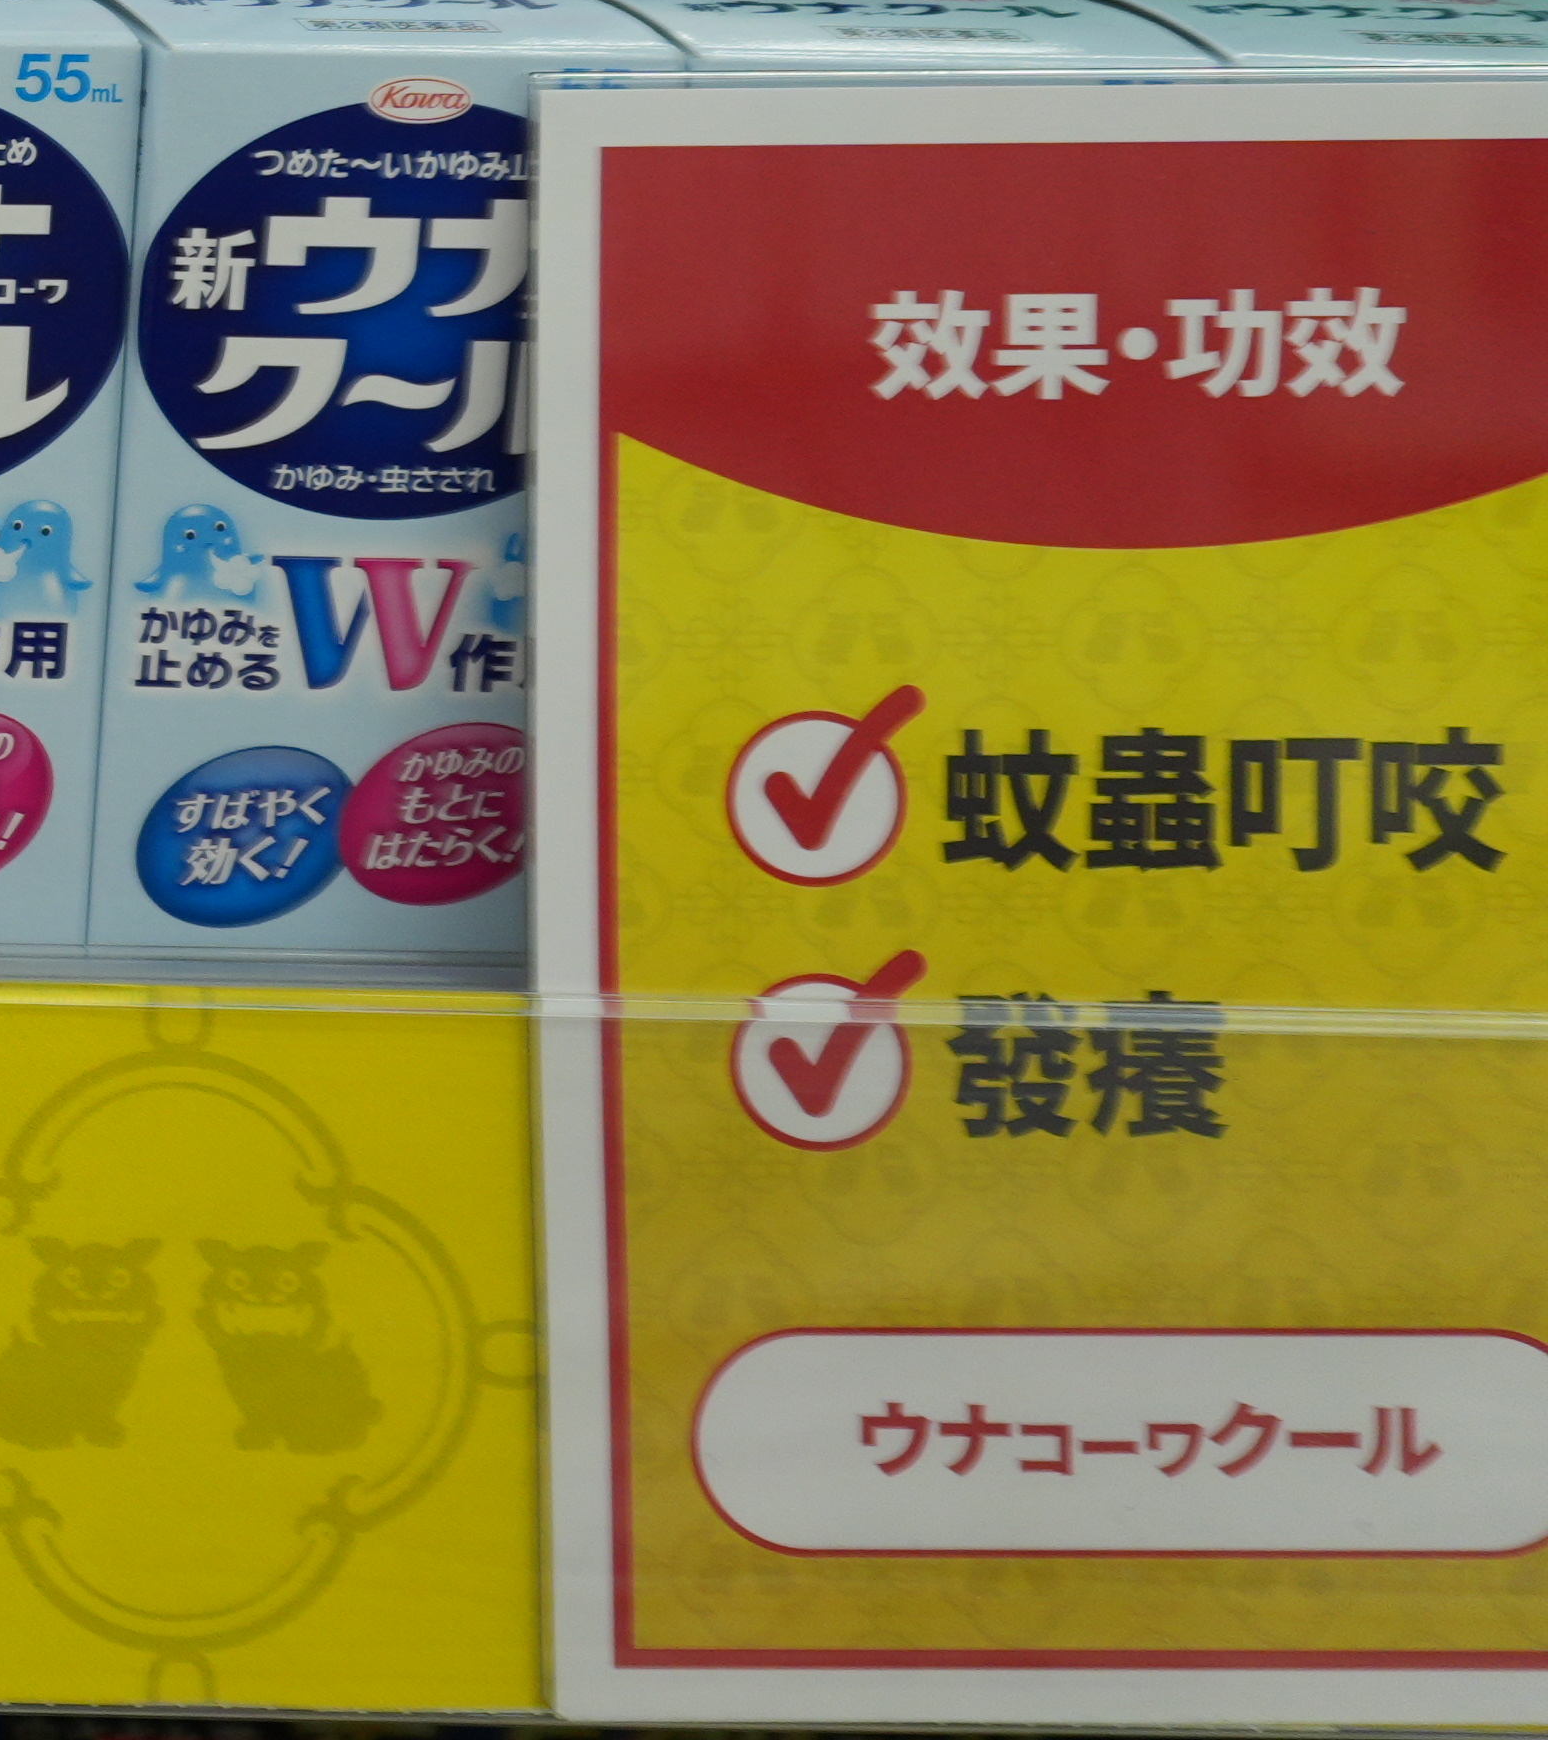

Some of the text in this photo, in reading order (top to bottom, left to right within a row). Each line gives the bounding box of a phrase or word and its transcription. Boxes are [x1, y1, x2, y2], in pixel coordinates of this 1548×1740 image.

[16, 56, 124, 104] 55mL
[175, 784, 330, 835] すばやく
[941, 725, 1507, 874] 蚊蟲叮咬
[946, 991, 1229, 1139] 發癢
[858, 1400, 1444, 1478] ウナコーワクール
